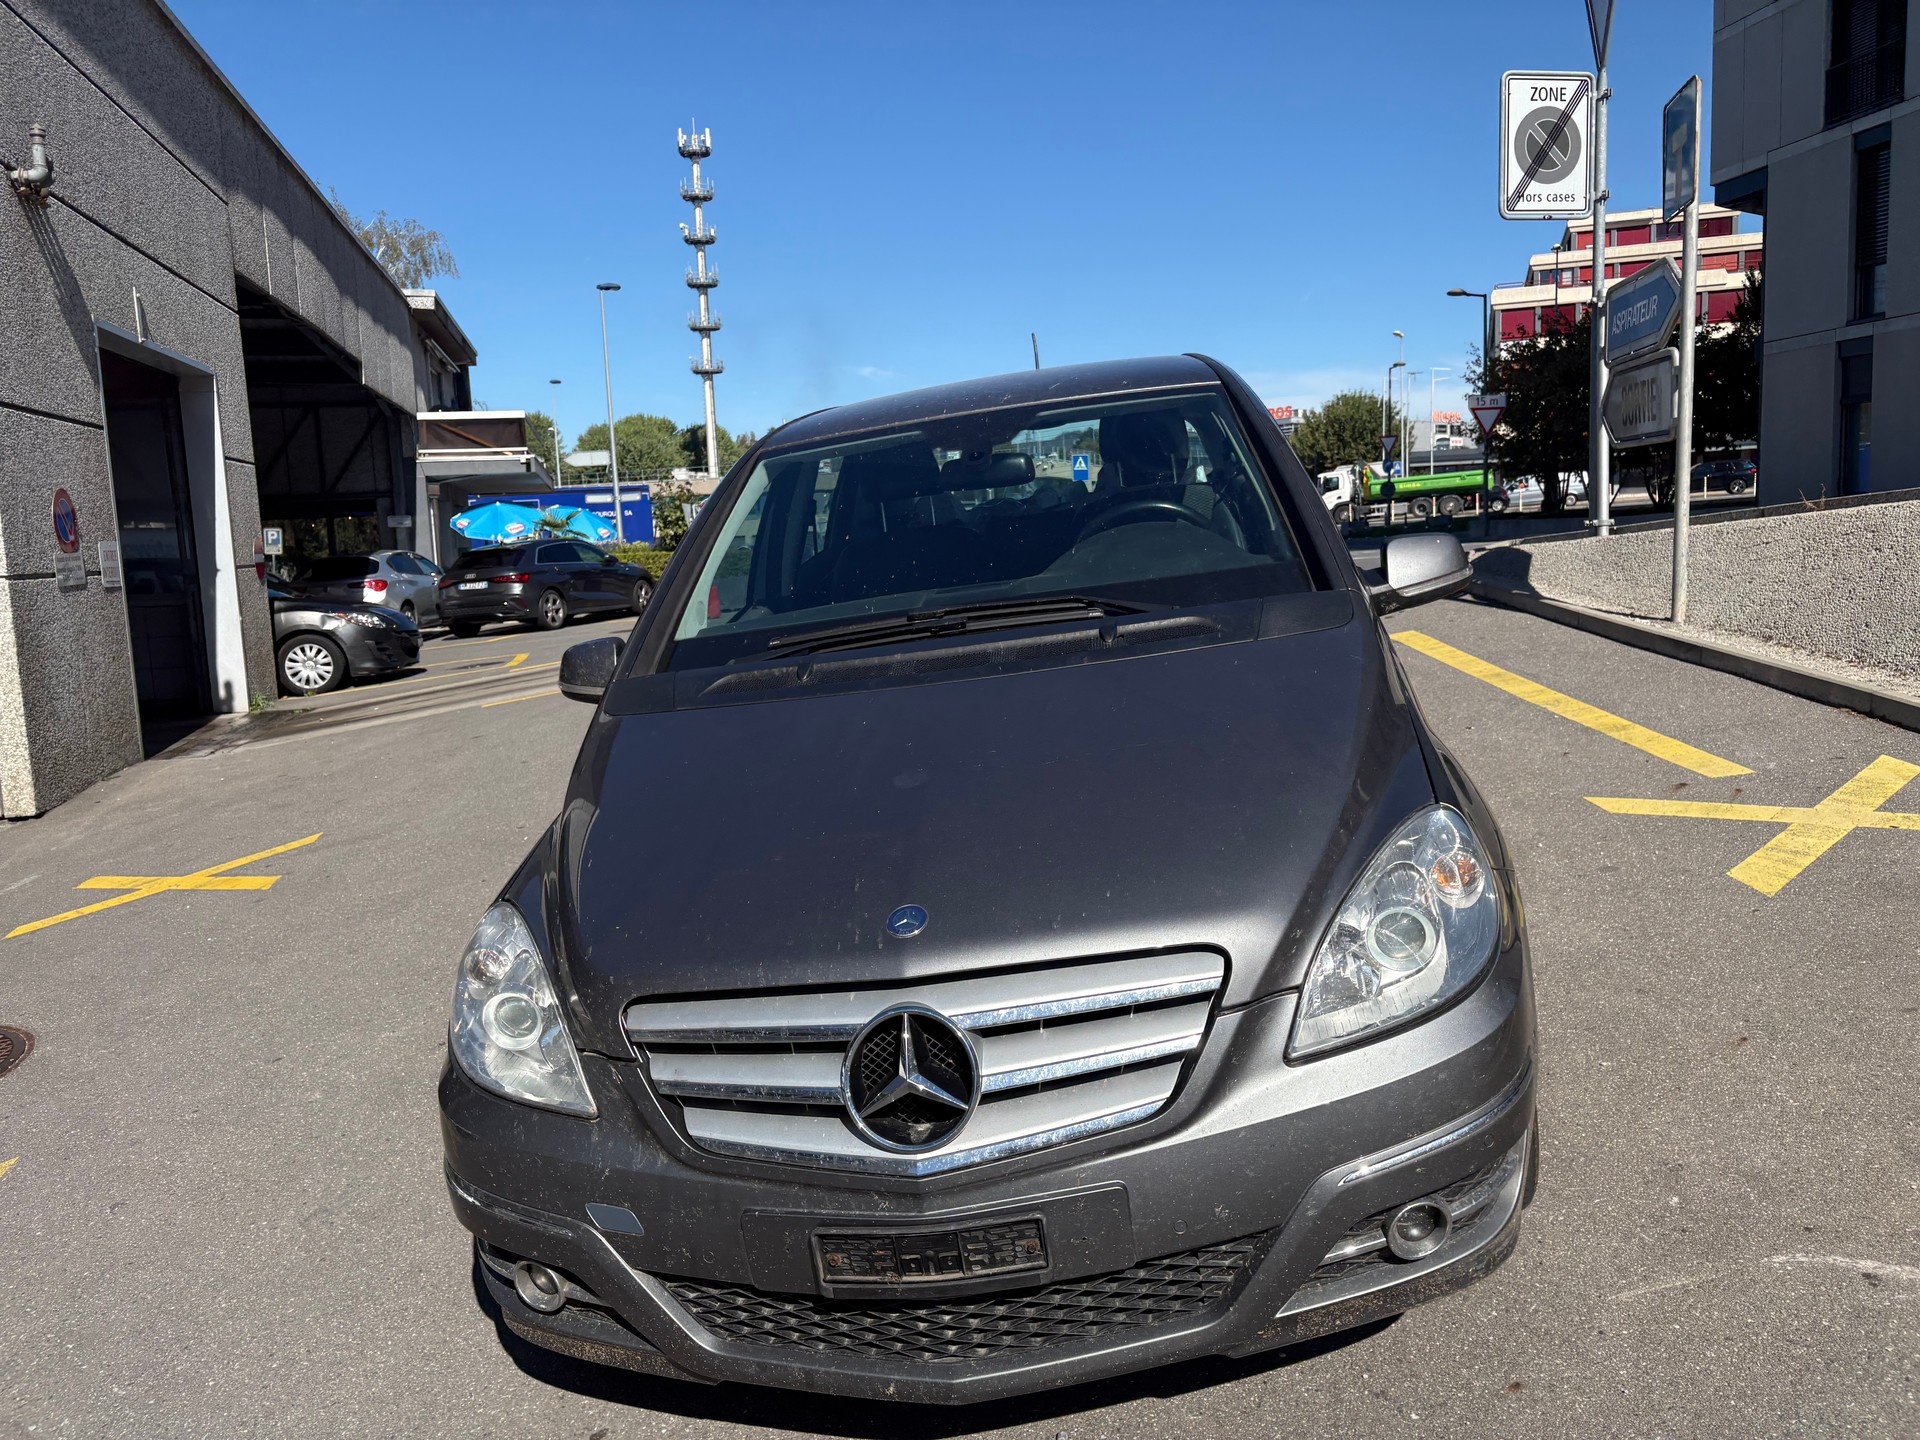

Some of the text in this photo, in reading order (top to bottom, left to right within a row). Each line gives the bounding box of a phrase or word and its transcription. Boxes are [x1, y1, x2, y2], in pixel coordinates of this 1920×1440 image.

[1530, 86, 1567, 102] ZONE
[1546, 193, 1576, 203] cases
[1611, 294, 1658, 335] ASPIRATEUR
[1476, 396, 1499, 406] 15 m
[267, 531, 278, 544] P
